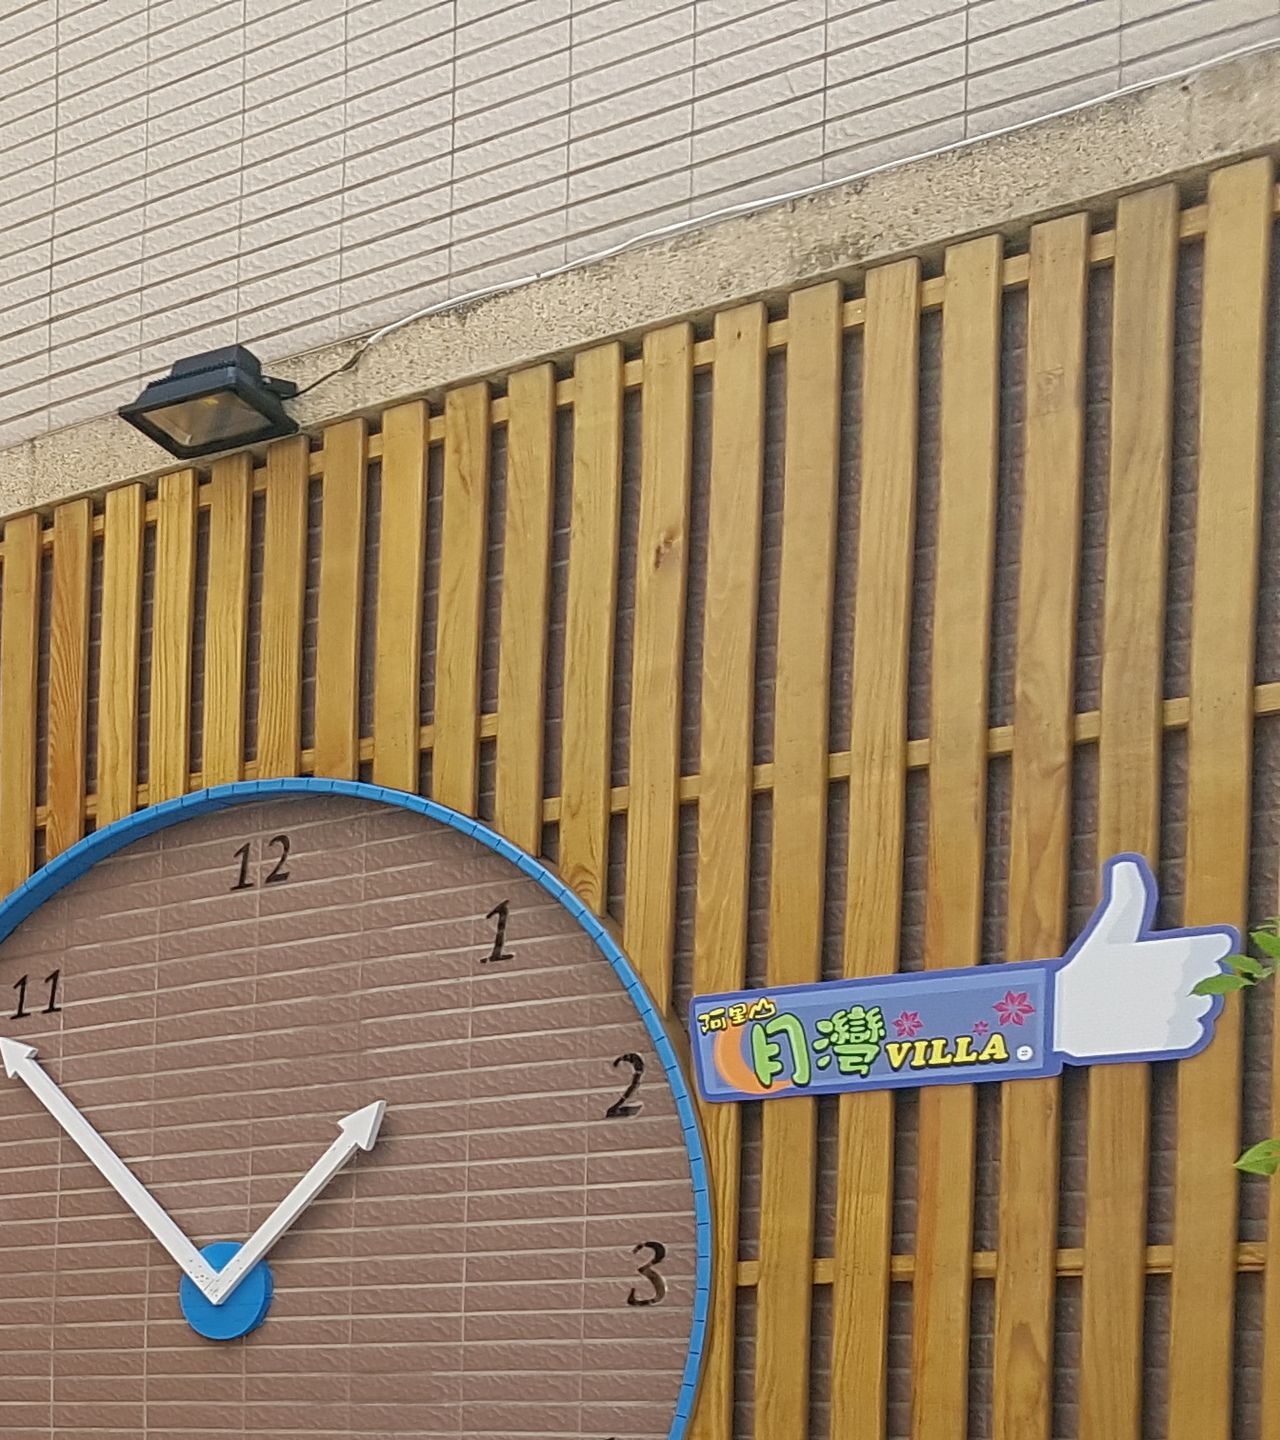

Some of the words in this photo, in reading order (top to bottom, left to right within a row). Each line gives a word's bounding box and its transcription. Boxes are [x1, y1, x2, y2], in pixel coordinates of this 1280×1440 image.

[229, 833, 292, 893] 12
[478, 899, 515, 965] 1
[8, 968, 64, 1021] 11
[698, 997, 776, 1034] 阿里山
[885, 1032, 1010, 1072] VILLA
[604, 1051, 646, 1120] 2
[625, 1240, 668, 1307] 3
